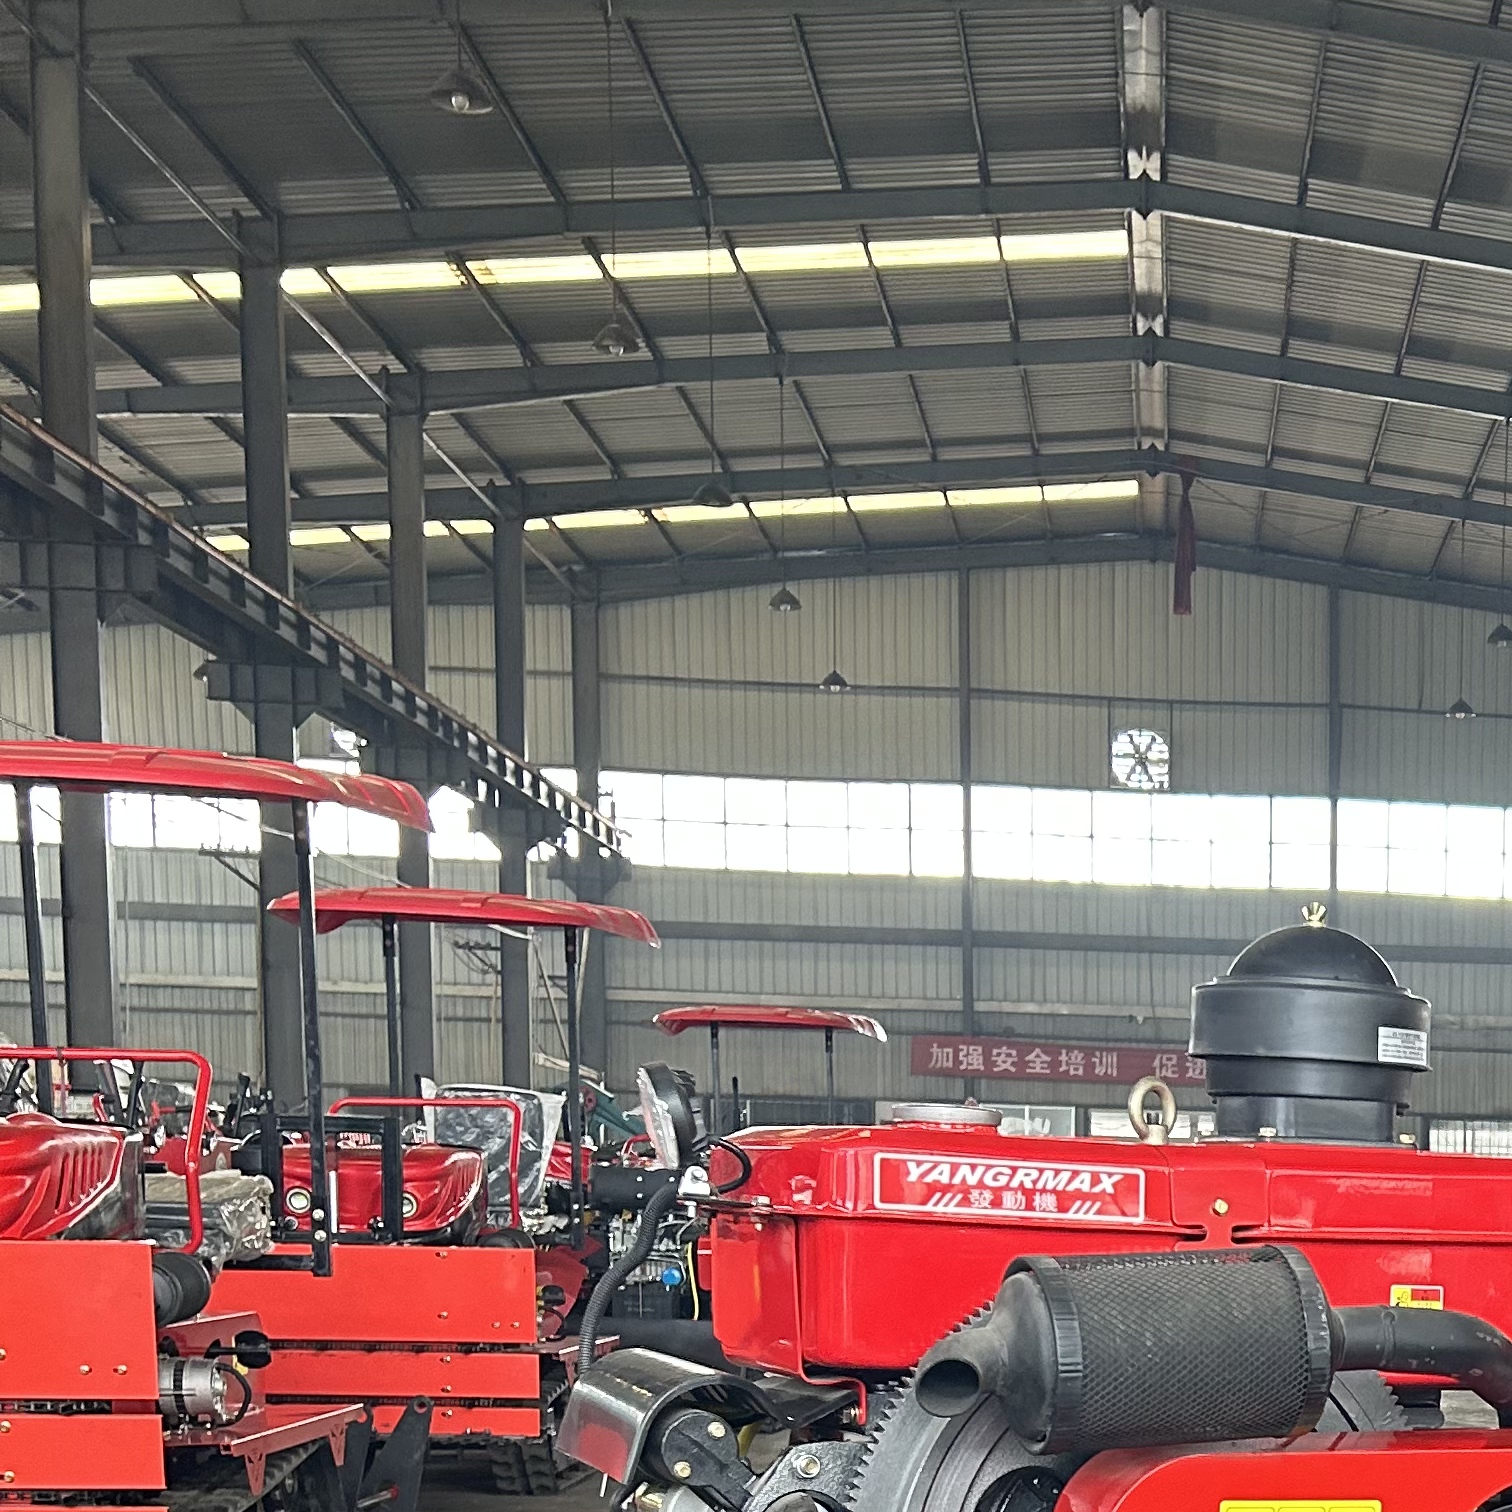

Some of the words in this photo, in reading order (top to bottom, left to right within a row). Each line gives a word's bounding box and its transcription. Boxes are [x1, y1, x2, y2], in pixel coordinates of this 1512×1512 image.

[929, 1043, 1118, 1077] 加强安全培训
[905, 1160, 1124, 1194] YANGRMAX
[967, 1188, 1060, 1213] 發動機
